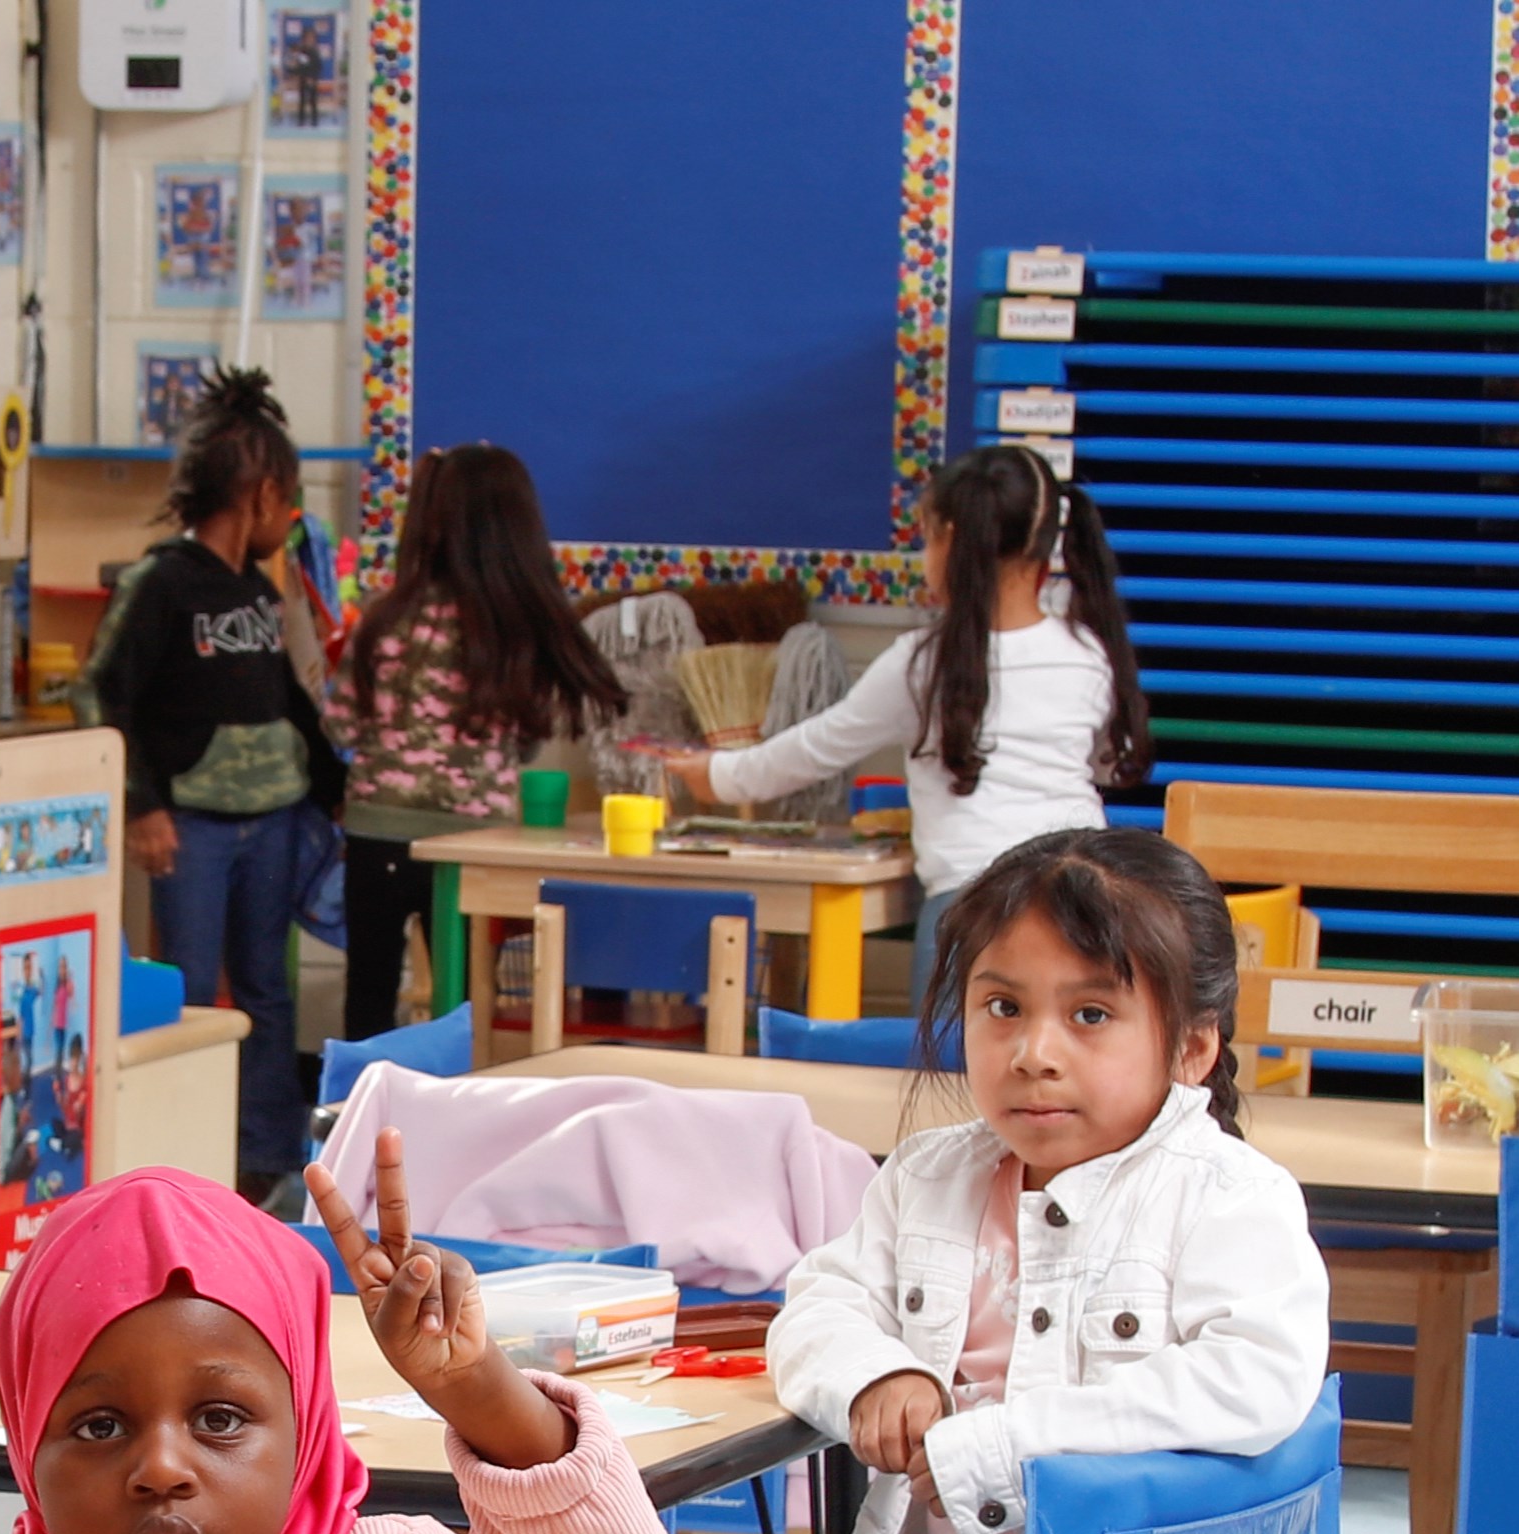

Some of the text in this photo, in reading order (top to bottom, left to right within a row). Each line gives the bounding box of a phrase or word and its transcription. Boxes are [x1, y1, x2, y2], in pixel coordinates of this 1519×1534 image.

[193, 595, 284, 657] KIN
[1313, 997, 1378, 1024] chair
[608, 1322, 653, 1346] Estefania
